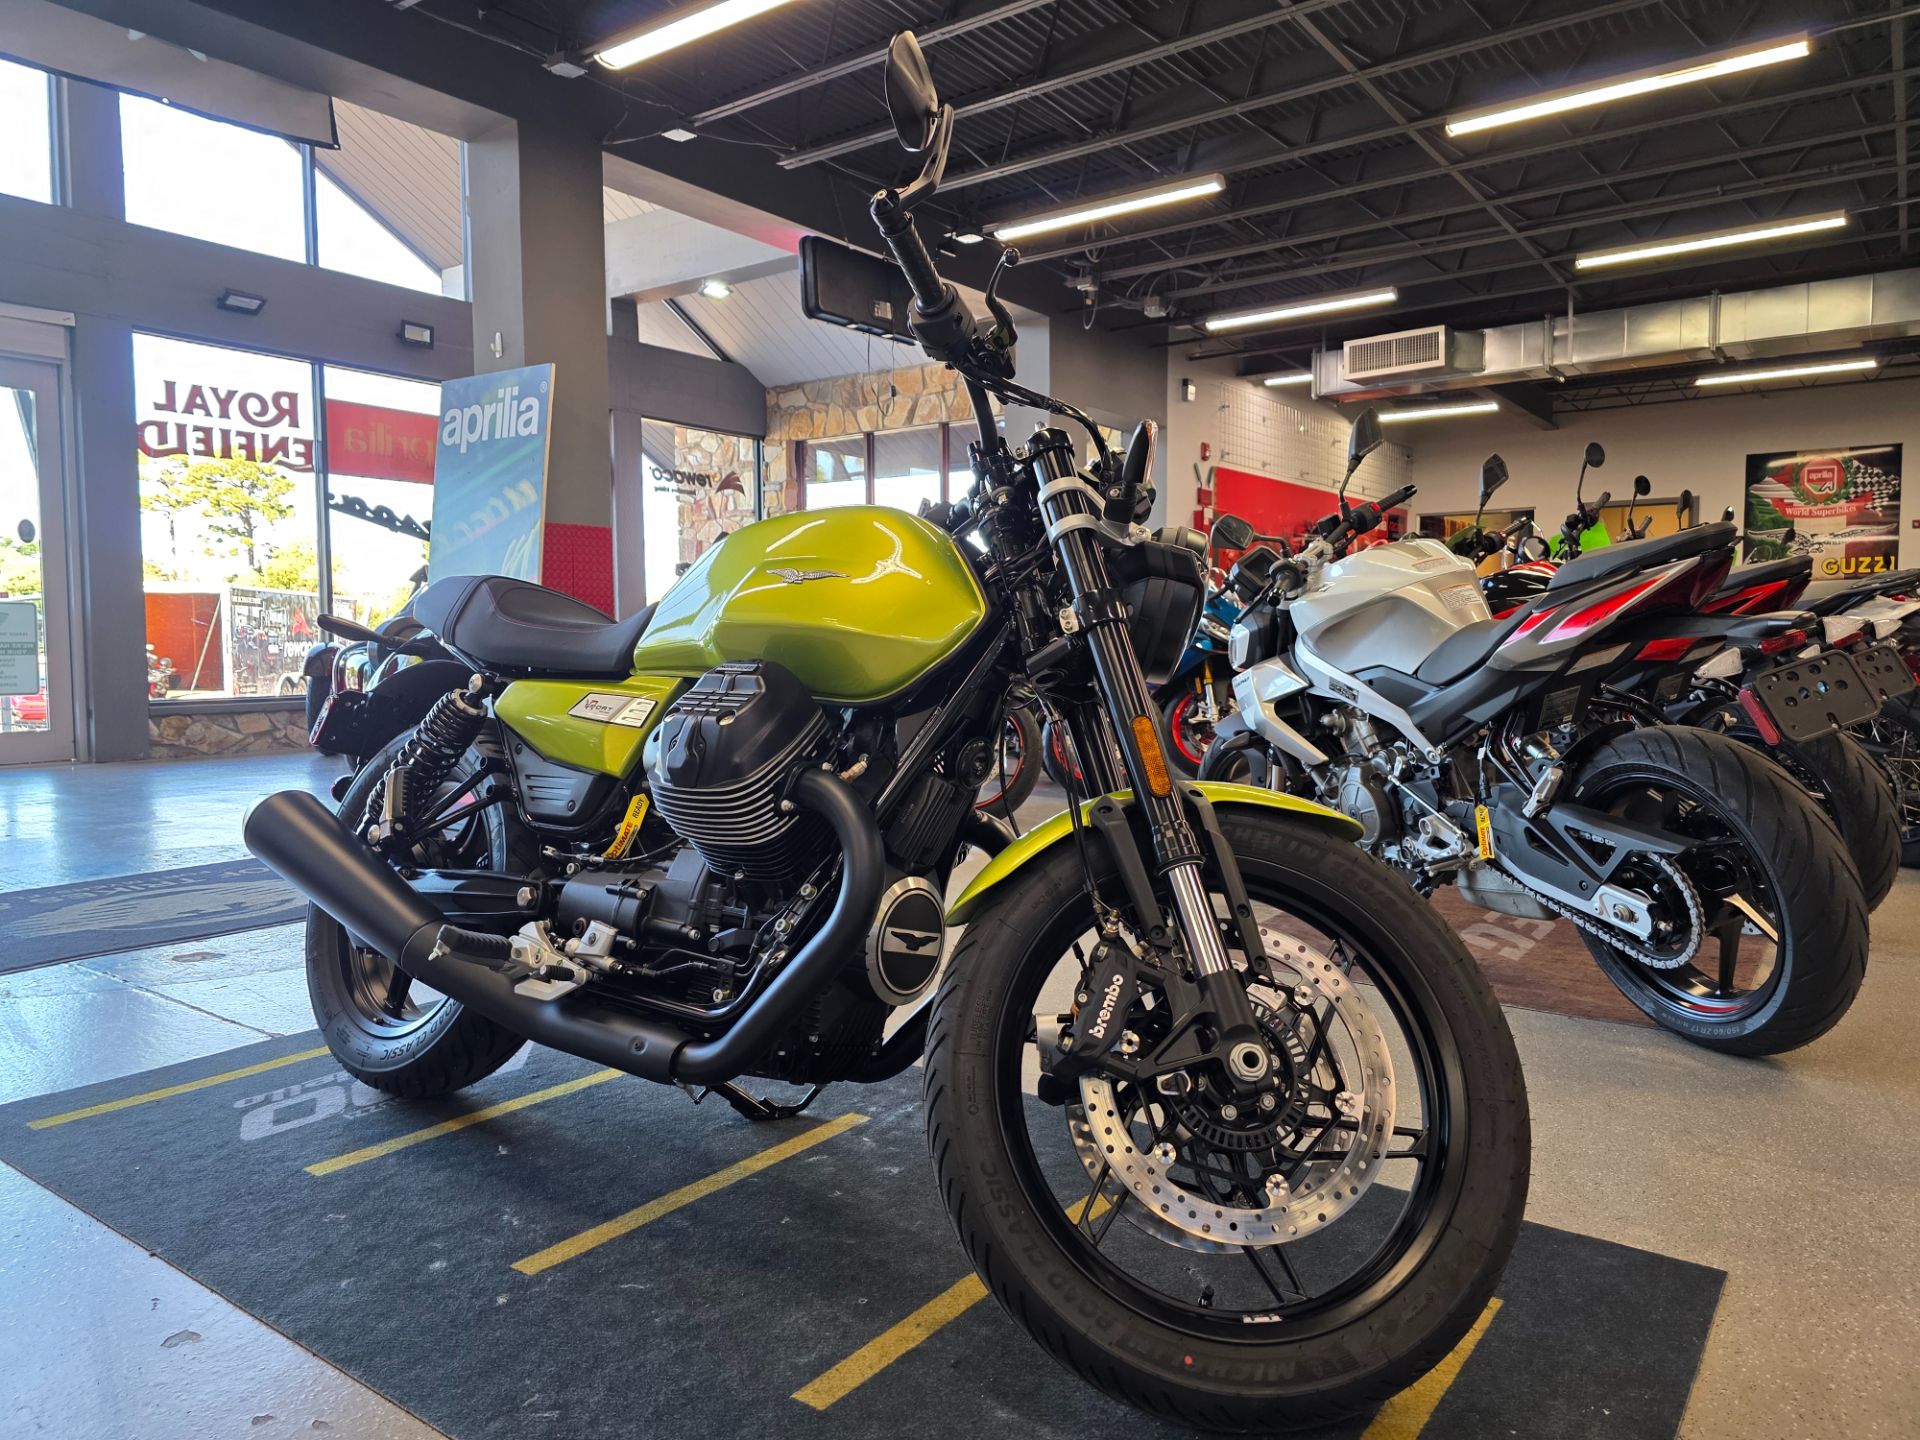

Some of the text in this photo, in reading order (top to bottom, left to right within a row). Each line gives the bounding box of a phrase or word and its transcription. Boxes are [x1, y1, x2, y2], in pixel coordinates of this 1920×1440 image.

[442, 386, 540, 454] aprilia
[1808, 470, 1833, 481] aprilia
[1785, 505, 1857, 517] World Superbikes
[1088, 974, 1124, 1039] brembo
[379, 1034, 427, 1062] CLASSIC
